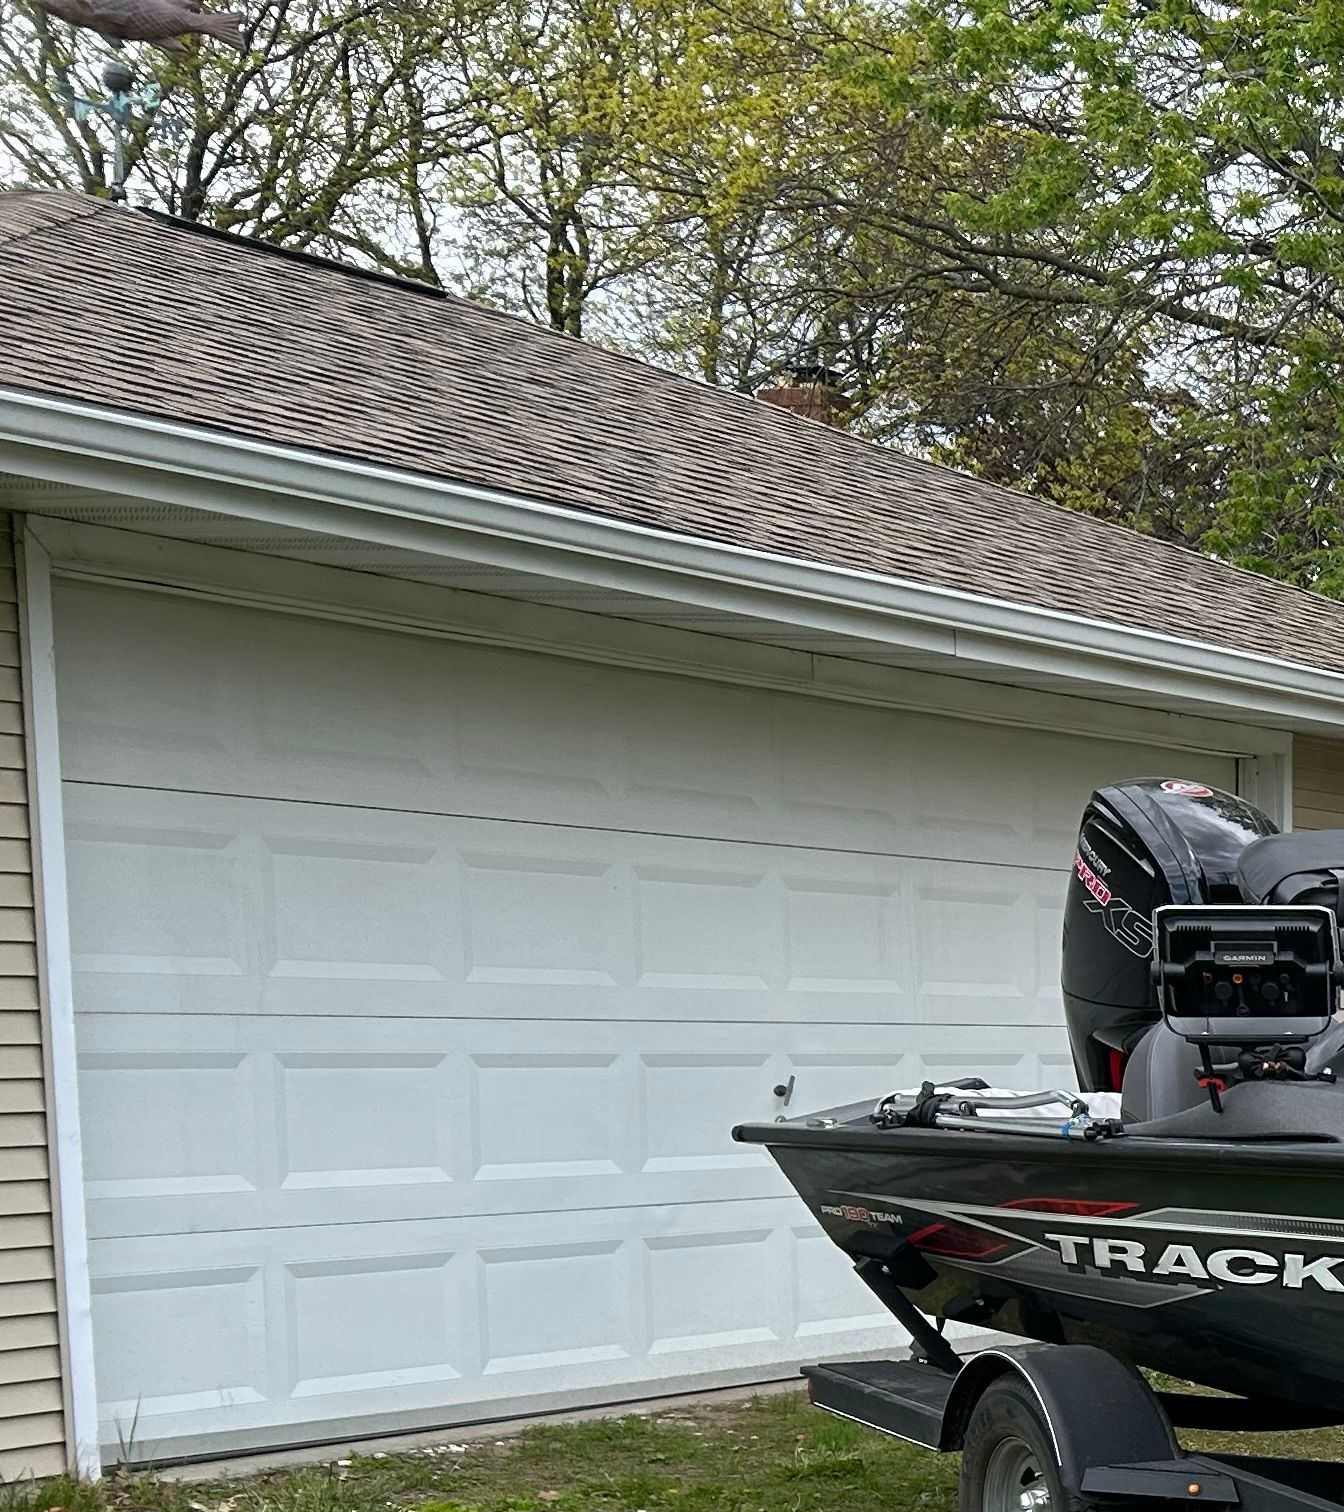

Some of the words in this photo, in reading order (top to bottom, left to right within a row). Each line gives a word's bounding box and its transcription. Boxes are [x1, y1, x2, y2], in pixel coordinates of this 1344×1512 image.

[1082, 897, 1156, 959] XS
[1222, 954, 1267, 962] GARMIN
[869, 1211, 904, 1225] TEAM
